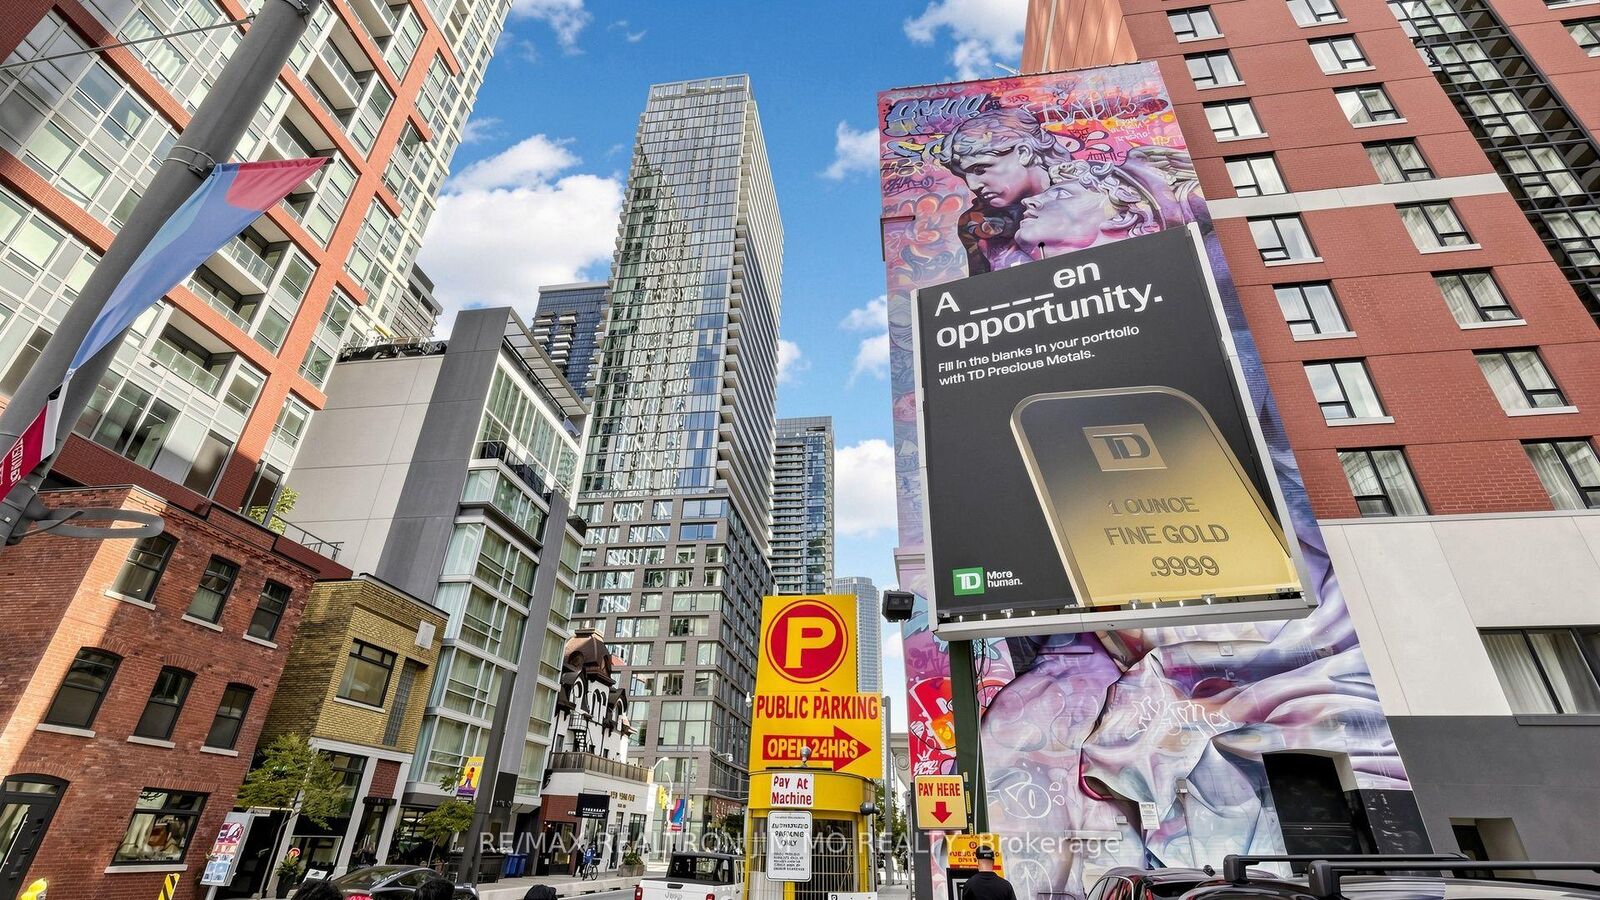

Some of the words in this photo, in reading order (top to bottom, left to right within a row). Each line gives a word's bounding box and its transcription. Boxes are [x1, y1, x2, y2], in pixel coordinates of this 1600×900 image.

[934, 291, 961, 317] A
[936, 283, 1163, 349] opportunity.
[938, 359, 954, 373] Fill
[956, 358, 968, 370] in
[968, 352, 990, 367] the
[992, 345, 1033, 363] blanks
[1034, 342, 1047, 354] in
[1049, 336, 1079, 353] your
[1081, 325, 1140, 346] portfolio
[938, 373, 966, 386] with
[967, 368, 986, 382] TD
[987, 358, 1044, 377] Precious
[1046, 350, 1096, 366] Metals.
[1092, 433, 1151, 460] TD
[1108, 499, 1123, 516] 1
[1124, 497, 1200, 515] OUNCE
[1104, 525, 1162, 546] FINE
[1162, 523, 1230, 544] GOLD
[1150, 555, 1220, 577] .9999
[956, 572, 981, 590] TD
[986, 570, 1013, 580] More
[987, 578, 1023, 588] human.
[784, 616, 837, 669] P
[756, 695, 808, 719] PUBLIC
[813, 695, 878, 720] PARKING
[811, 738, 859, 759] 24HRS
[773, 775, 790, 789] Pay
[796, 777, 809, 789] At
[918, 782, 934, 796] PAY
[937, 782, 961, 796] HERE
[771, 791, 812, 805] Machine
